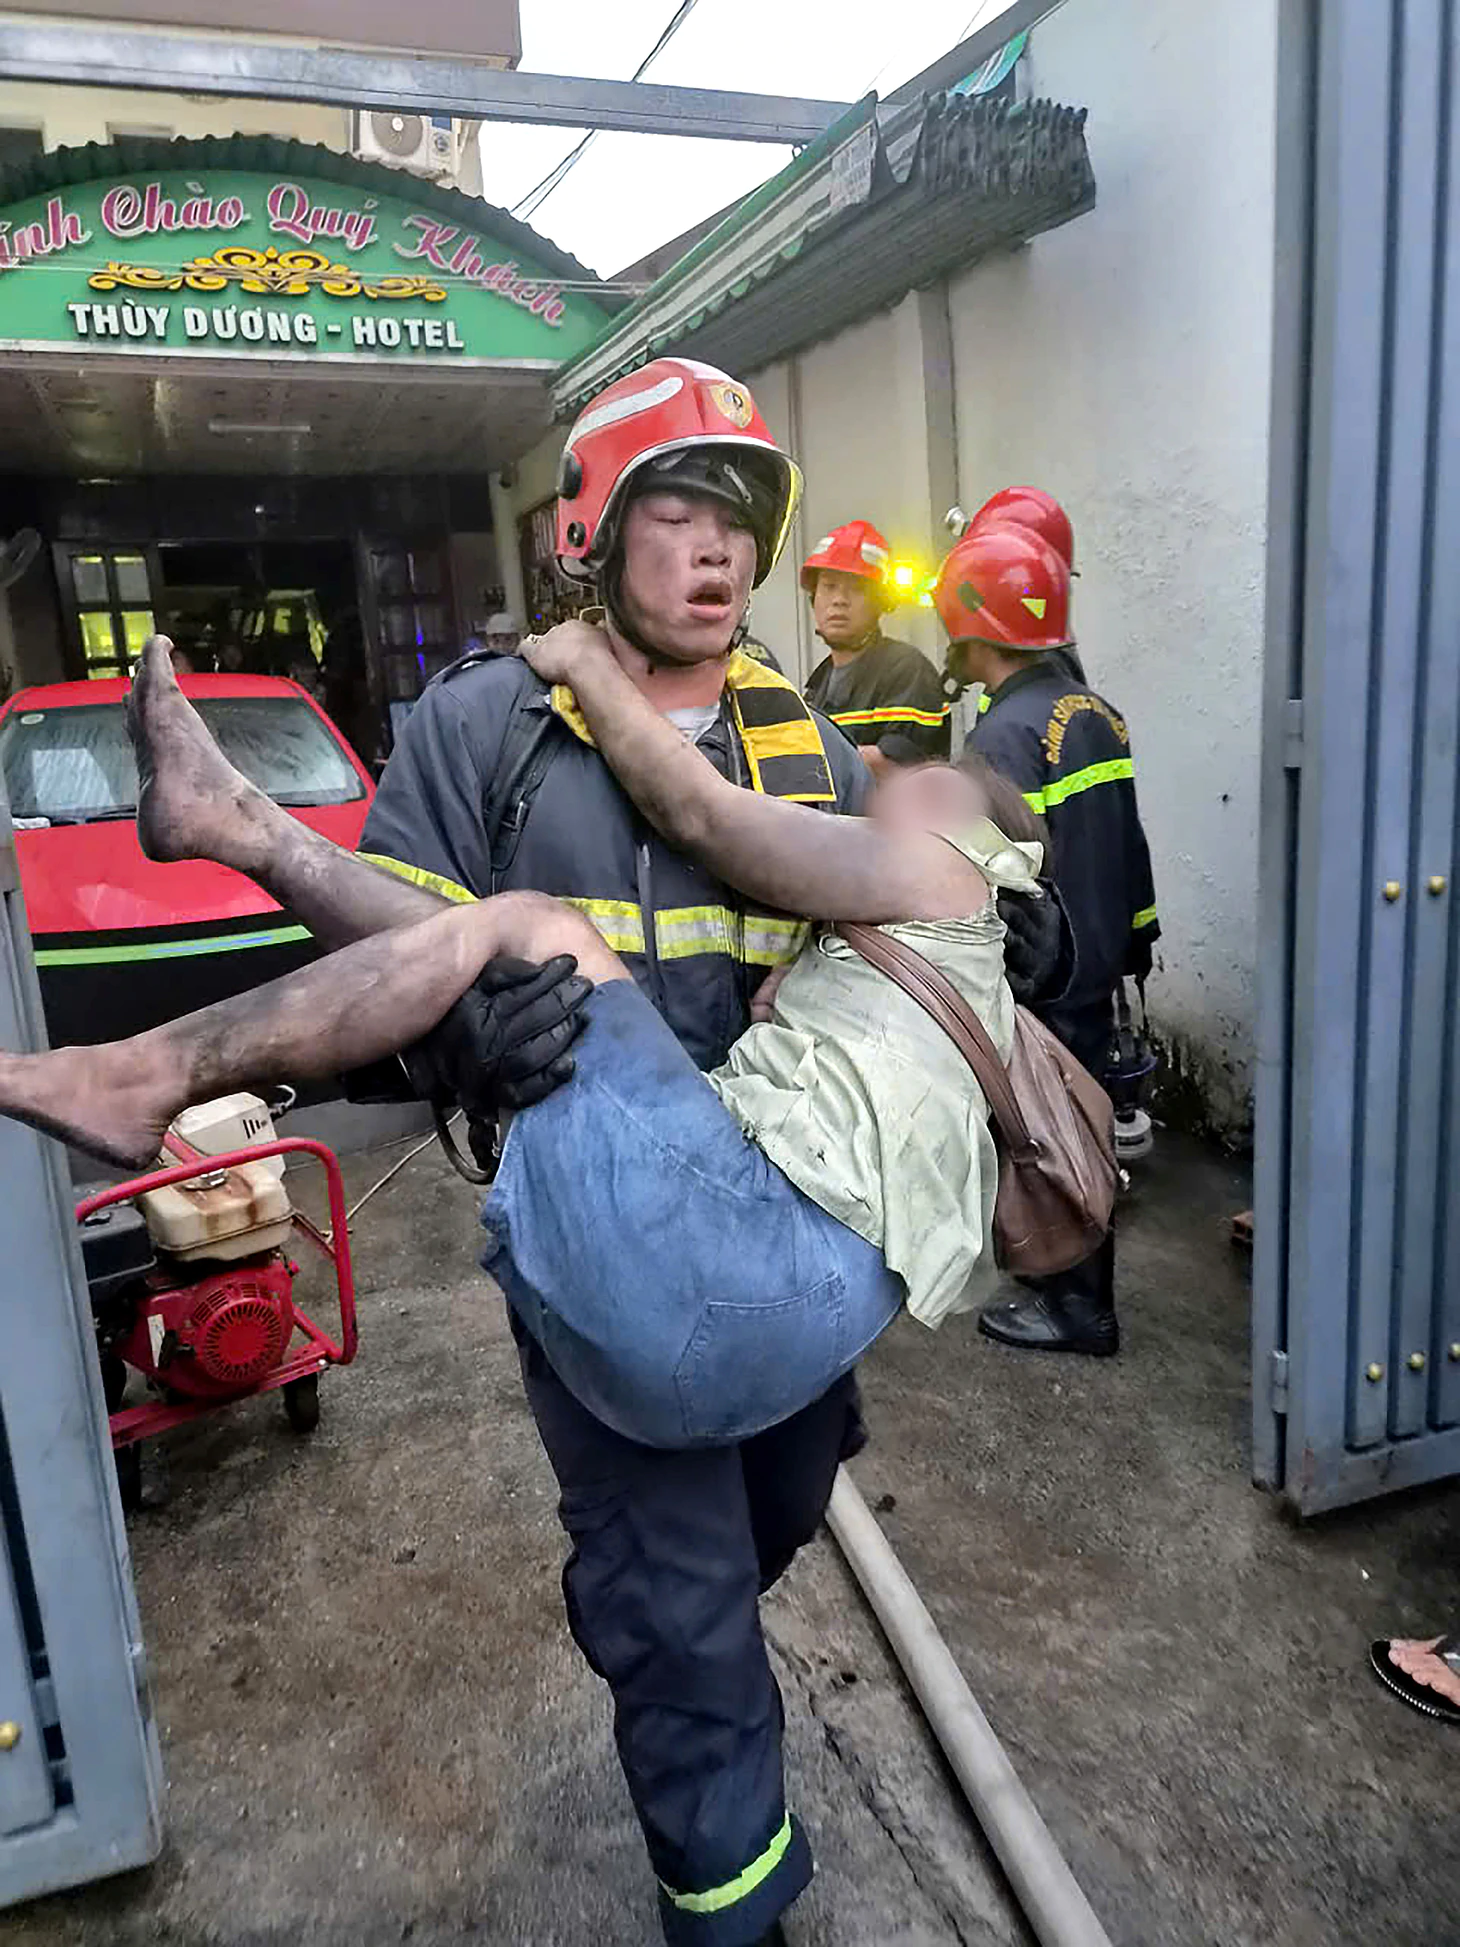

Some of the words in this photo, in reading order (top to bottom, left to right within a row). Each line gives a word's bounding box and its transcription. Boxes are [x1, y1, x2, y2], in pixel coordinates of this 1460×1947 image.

[101, 182, 251, 238] Chào
[267, 182, 379, 251] Quý
[392, 213, 567, 330] Khách
[68, 298, 170, 338] THÙY
[183, 305, 318, 344] DƯƠNG
[352, 316, 465, 350] HOTEL
